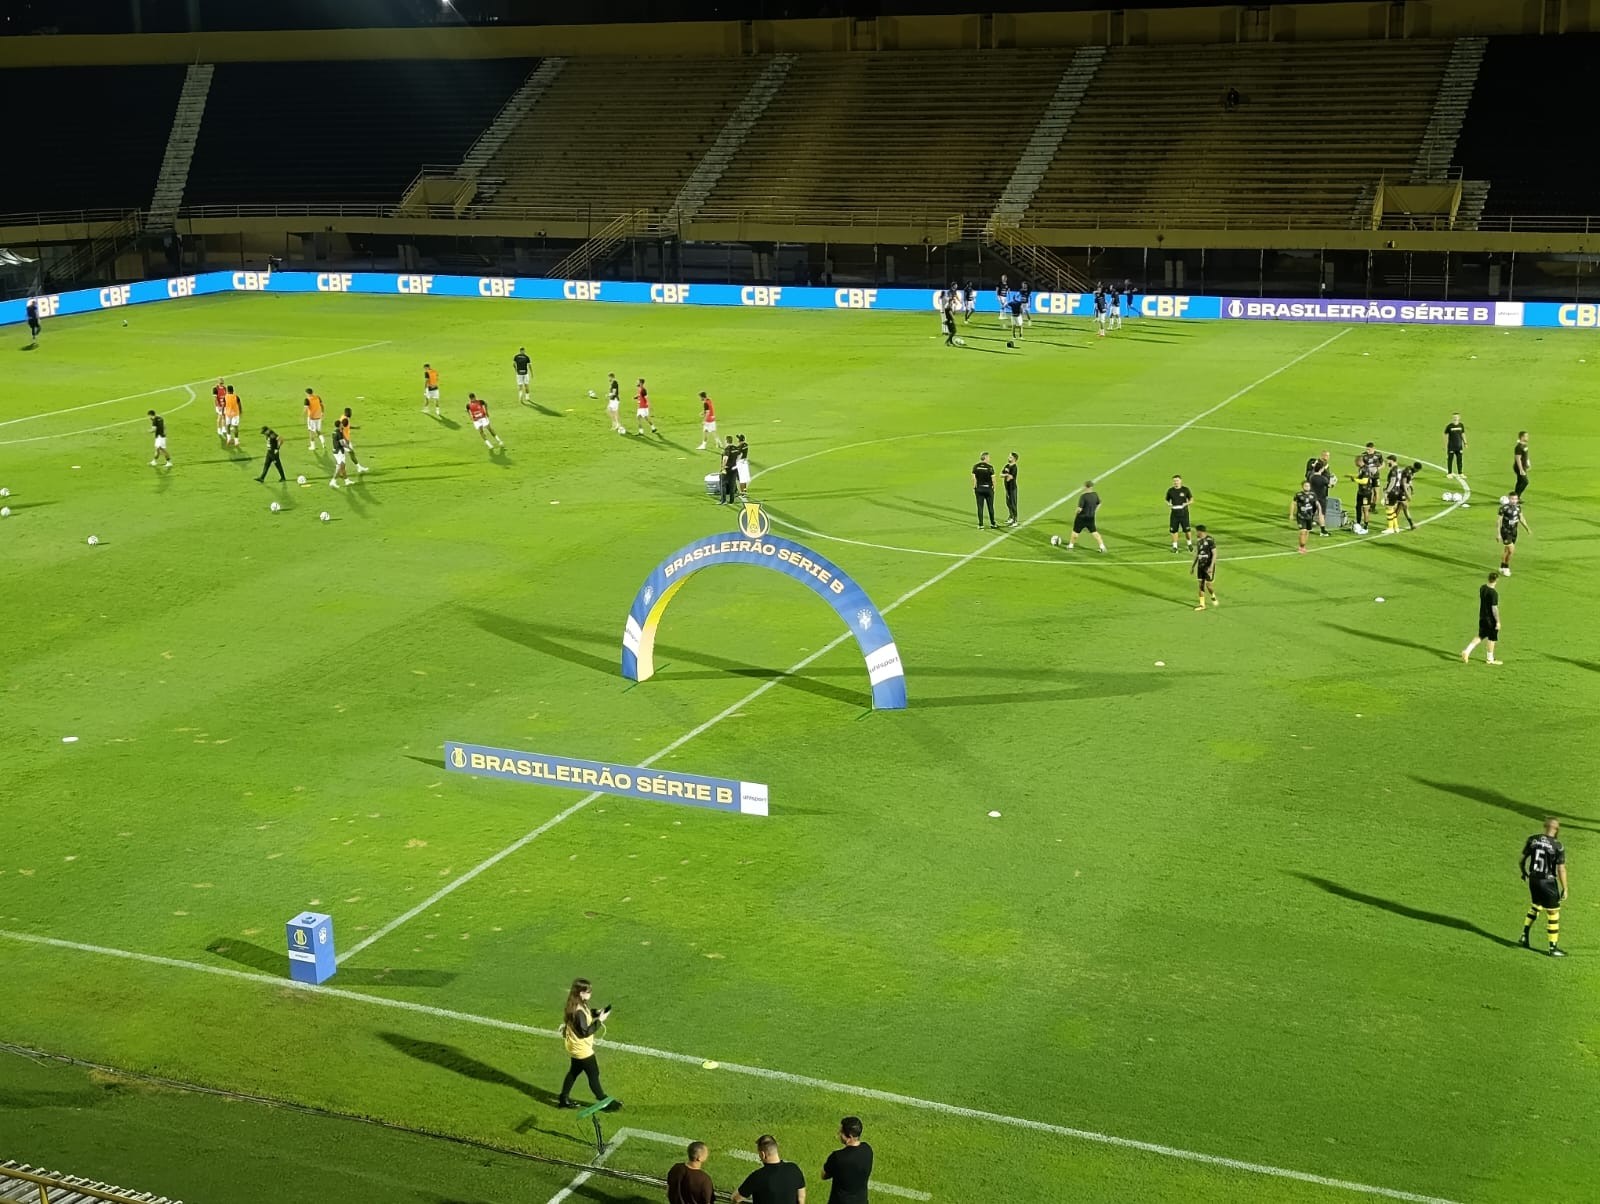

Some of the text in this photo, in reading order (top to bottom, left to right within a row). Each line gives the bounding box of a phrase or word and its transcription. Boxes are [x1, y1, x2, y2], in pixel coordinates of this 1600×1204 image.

[168, 276, 195, 297] CBF
[233, 272, 270, 290] CBF
[317, 273, 352, 292] CBF
[398, 275, 433, 293] CBF
[479, 278, 515, 297] CBF
[564, 281, 600, 300] CBF
[100, 284, 130, 307] CBF
[650, 284, 689, 304] CBF
[741, 286, 782, 307] CBF
[835, 288, 877, 309] CBF
[1035, 293, 1082, 314] CBF
[27, 296, 60, 318] BF
[1141, 296, 1190, 317] CBF
[1247, 302, 1489, 321] BRASILEIRÃO SÉRIE B
[1558, 304, 1600, 327] CB
[664, 539, 845, 595] BRASILEIRÃO SÉRIE B
[471, 753, 733, 804] BRASILEIRÃO SÉRIE B
